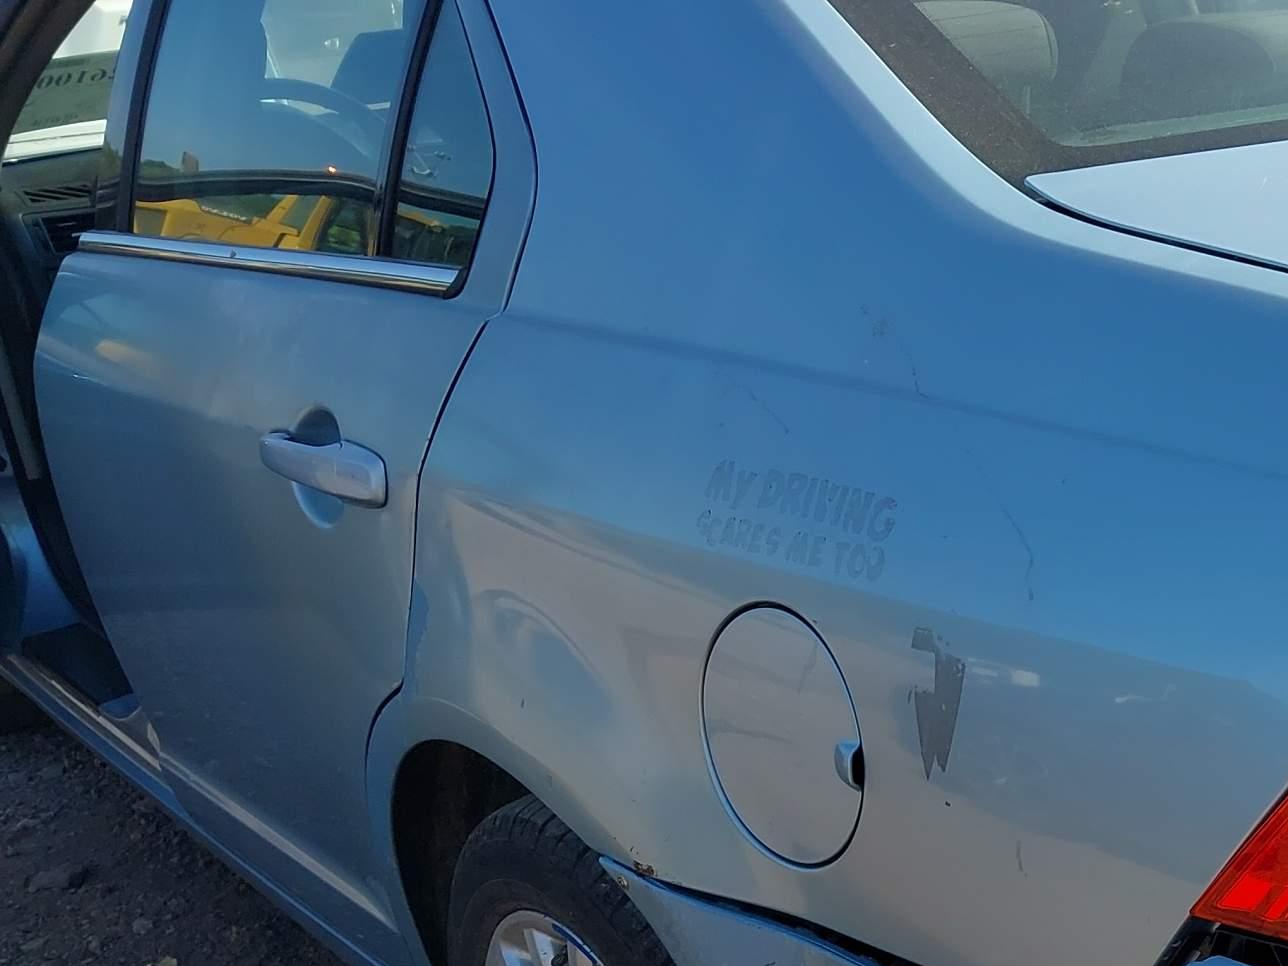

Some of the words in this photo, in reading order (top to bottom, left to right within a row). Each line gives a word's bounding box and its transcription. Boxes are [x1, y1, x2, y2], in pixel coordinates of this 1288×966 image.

[756, 467, 899, 542] DRIVING
[785, 530, 828, 567] ME
[832, 540, 886, 582] TOO
